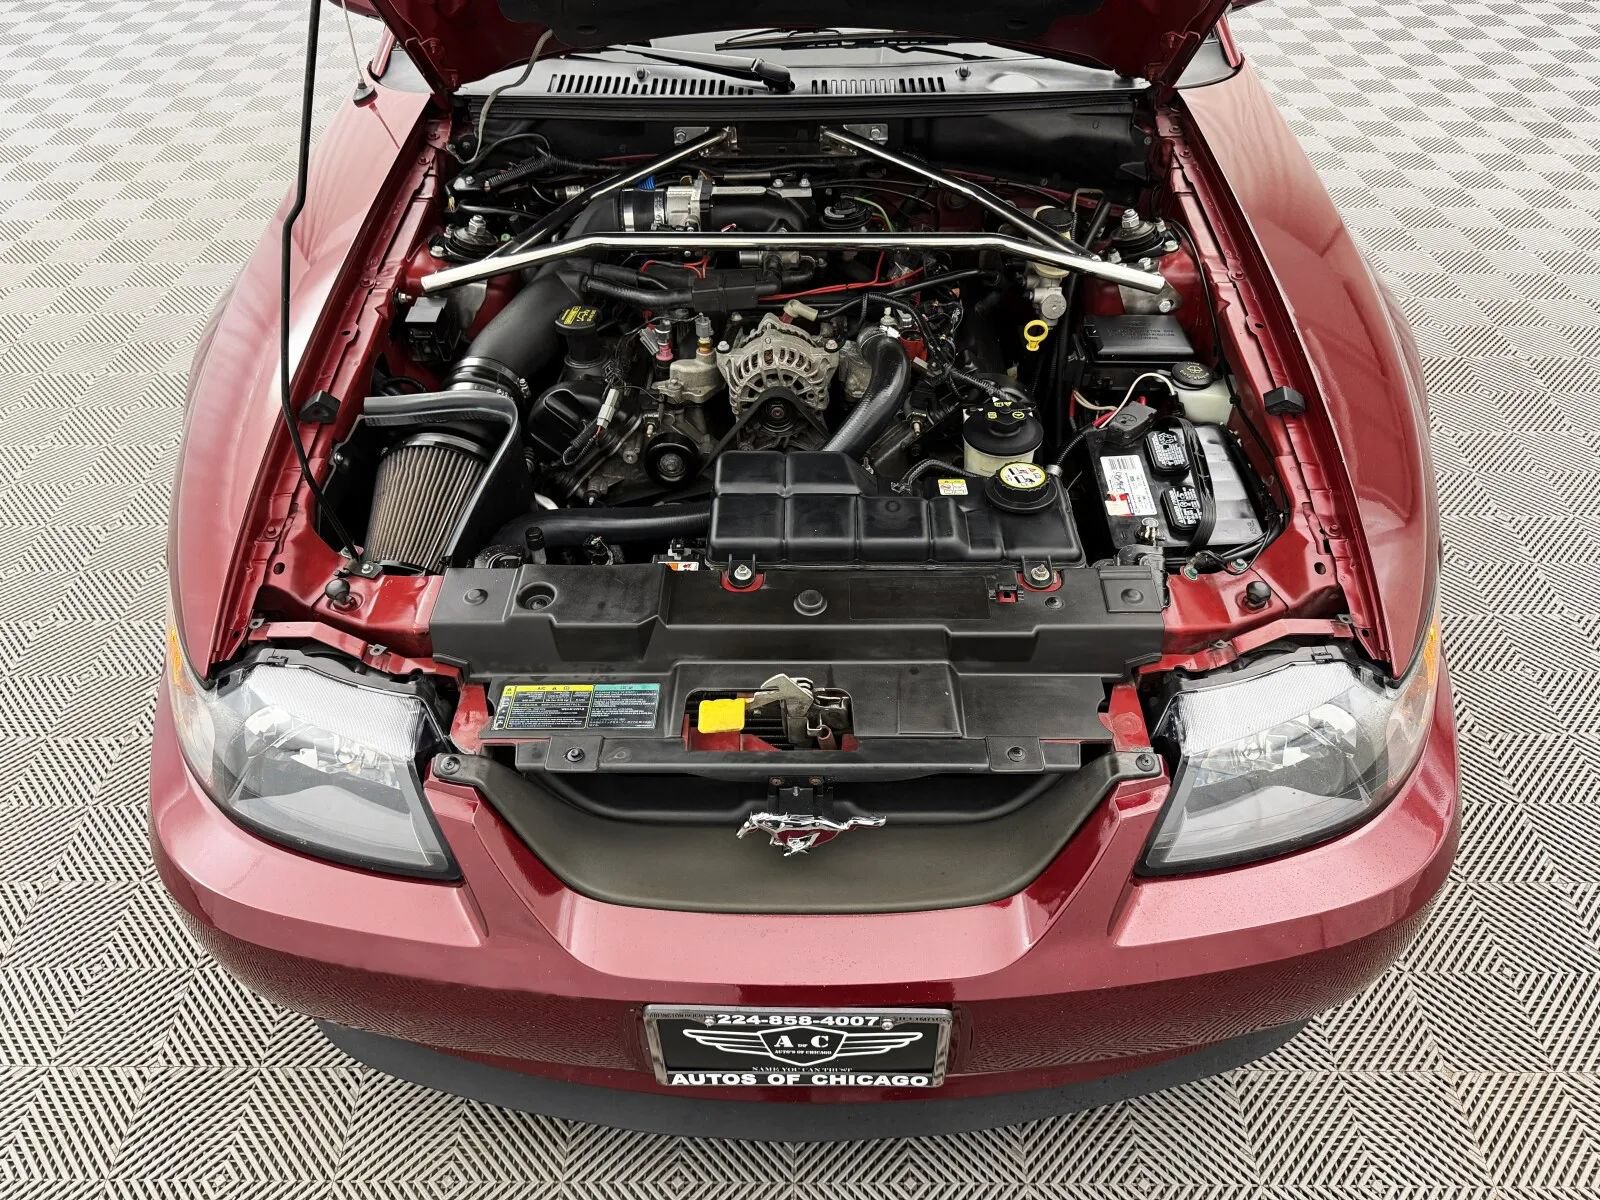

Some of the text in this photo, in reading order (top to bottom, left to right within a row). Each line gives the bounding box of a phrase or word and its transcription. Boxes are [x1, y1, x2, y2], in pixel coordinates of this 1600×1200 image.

[716, 1014, 880, 1026] 224-858-4007
[774, 1035, 794, 1048] A
[810, 1035, 829, 1048] C
[671, 1073, 929, 1087] AUTOS OF CHICAGO
